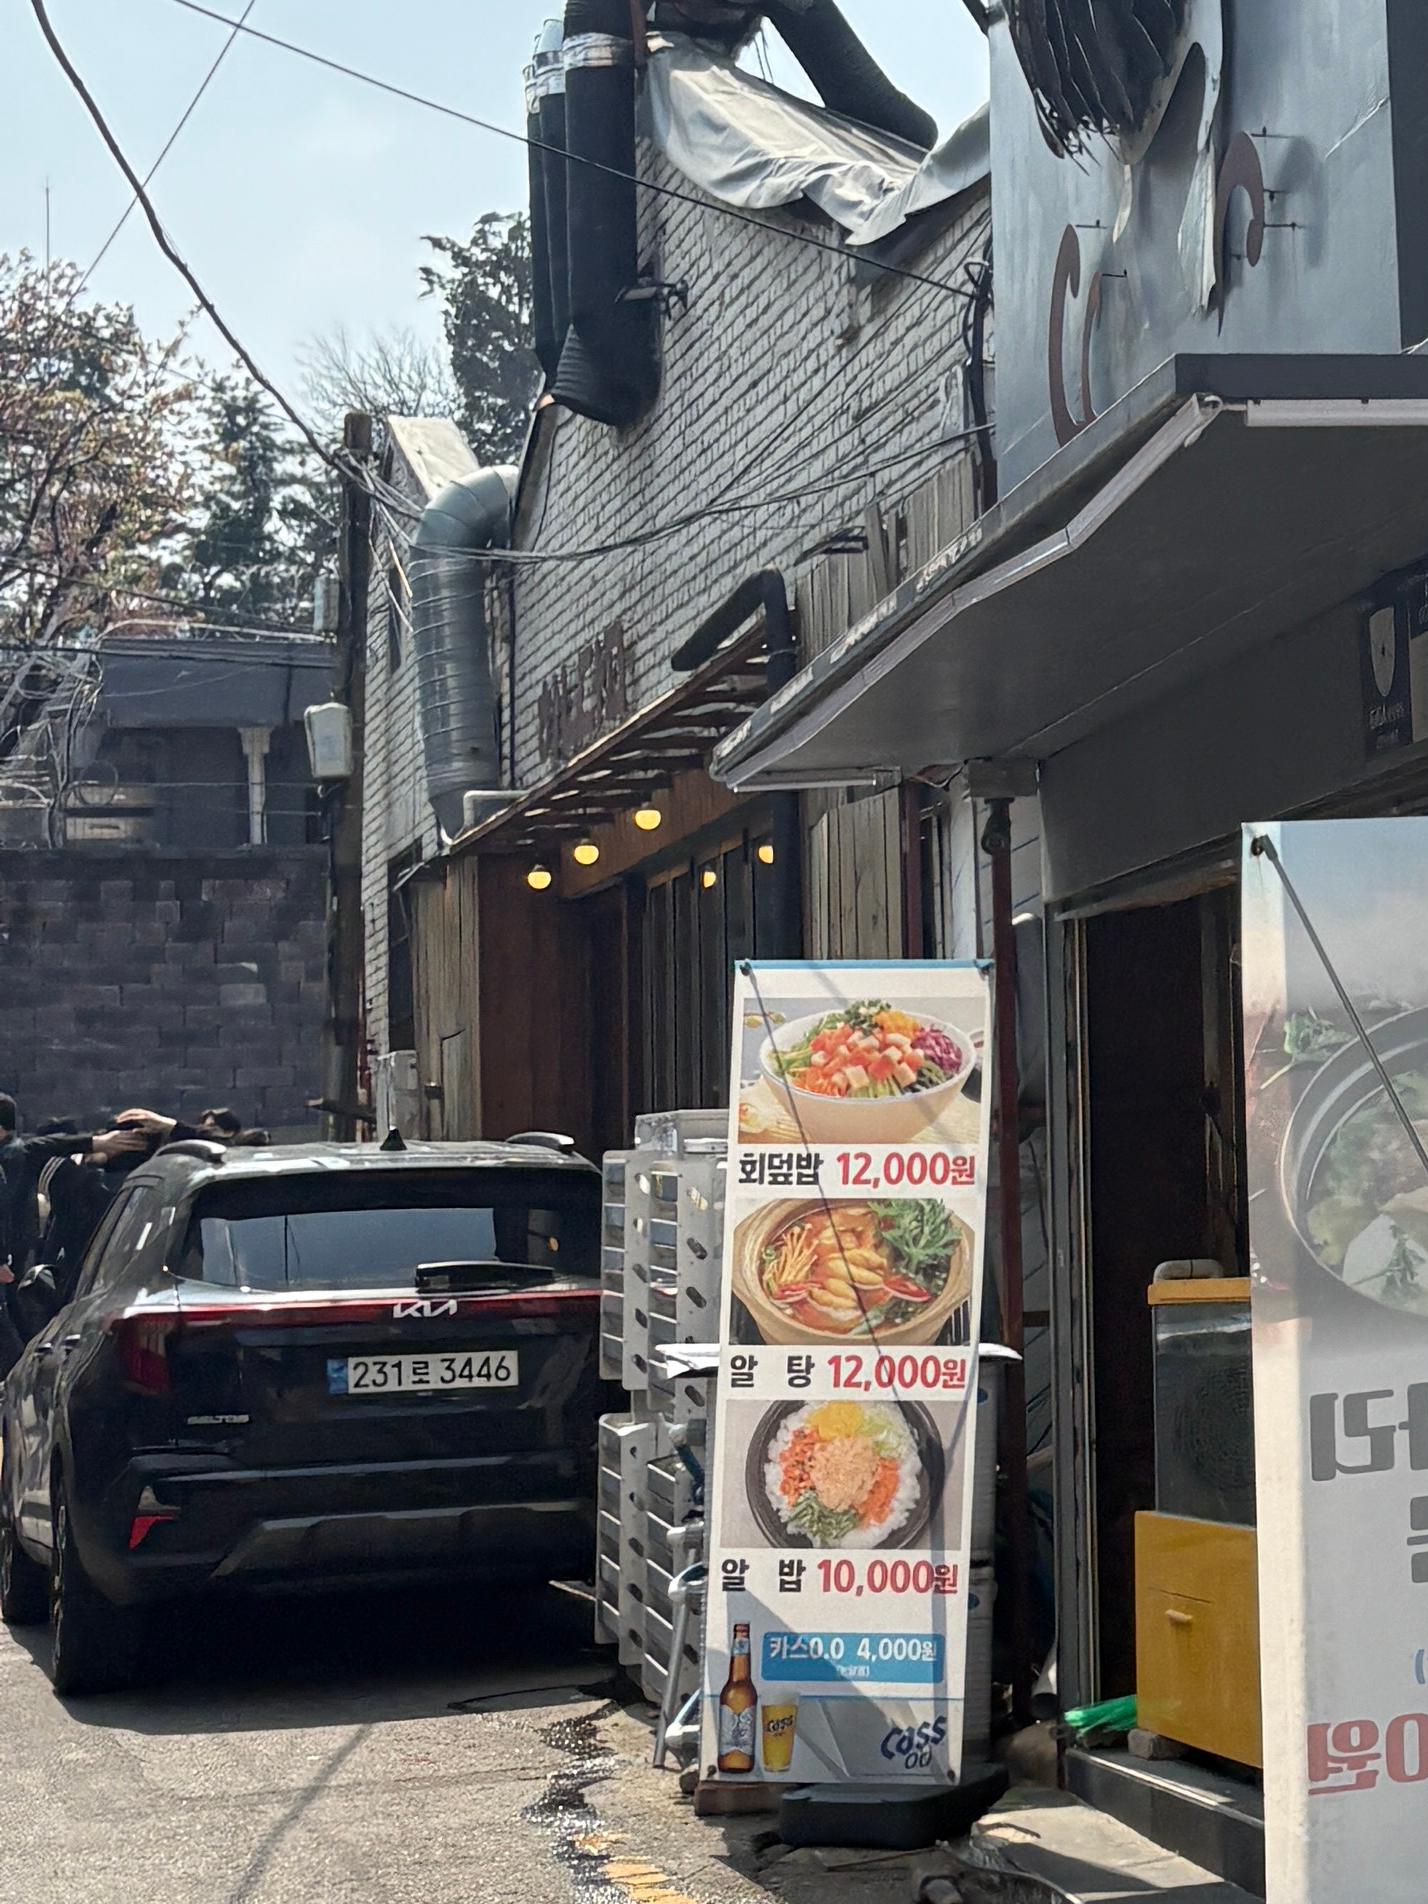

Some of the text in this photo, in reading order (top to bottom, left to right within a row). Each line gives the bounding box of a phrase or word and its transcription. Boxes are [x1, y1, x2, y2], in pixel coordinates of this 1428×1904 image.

[738, 1151, 976, 1189] 회덮밥 12,000원
[393, 1299, 457, 1318] KIA
[353, 1356, 511, 1389] 231로 3446
[730, 1354, 966, 1391] 알 탕 12,000원
[721, 1559, 959, 1596] 알 밥 10,000원
[769, 1636, 937, 1662] 카스0.0 4,000원
